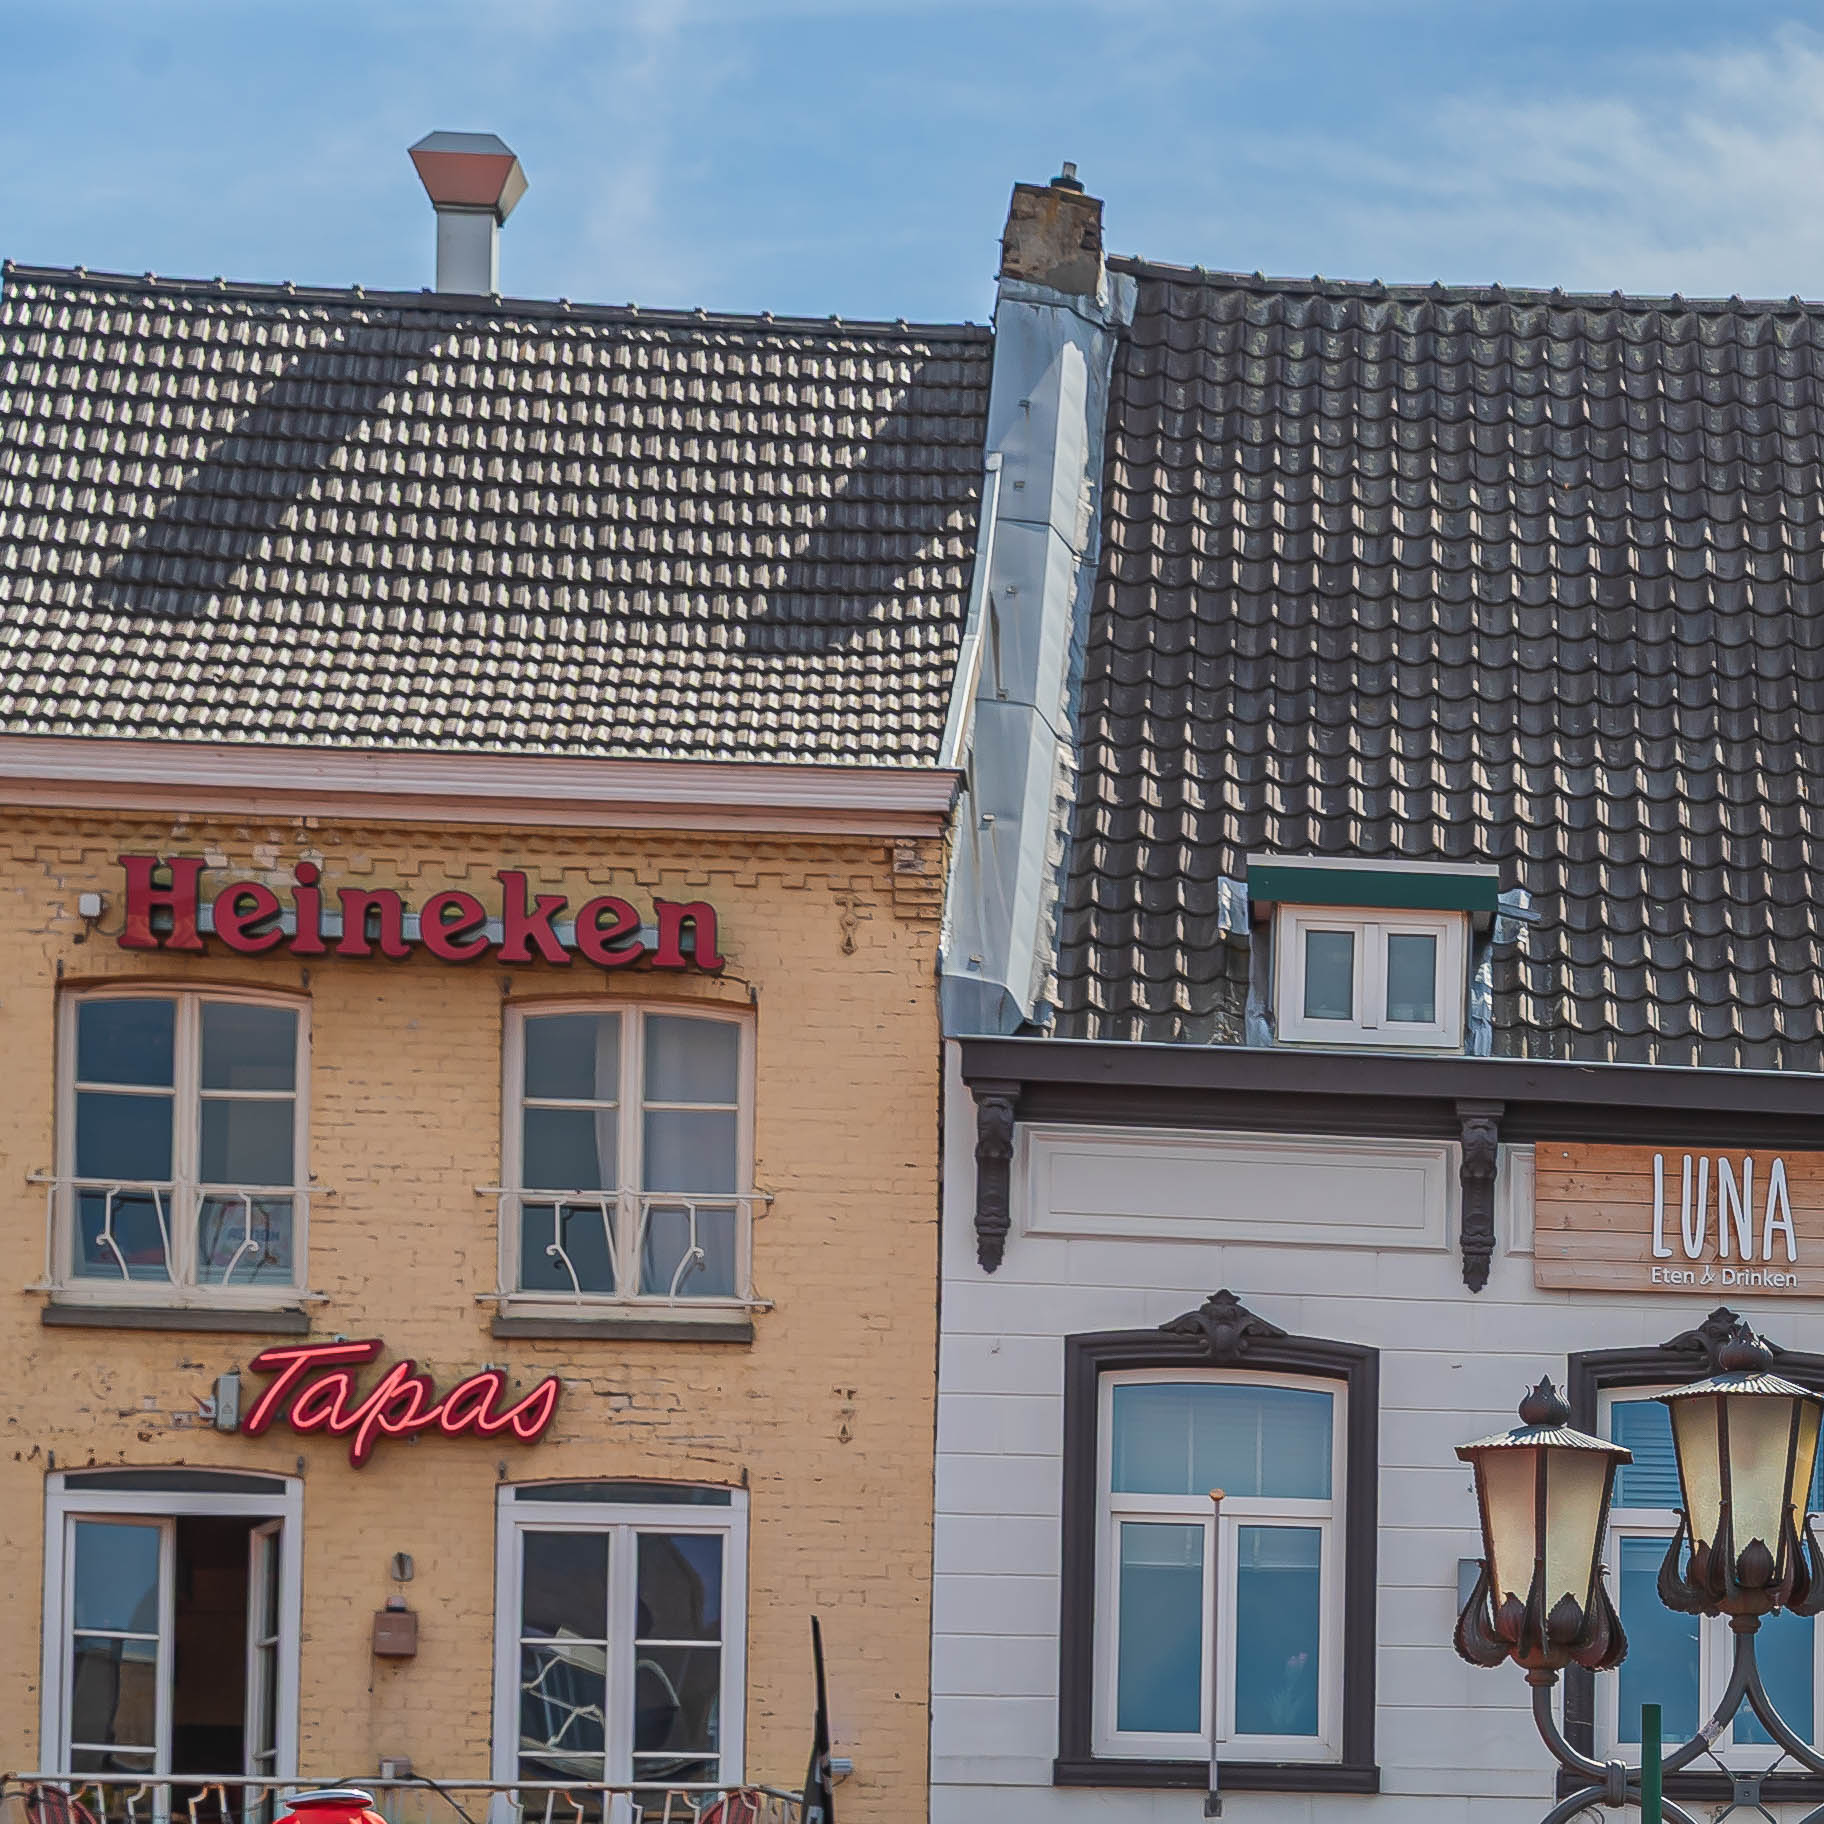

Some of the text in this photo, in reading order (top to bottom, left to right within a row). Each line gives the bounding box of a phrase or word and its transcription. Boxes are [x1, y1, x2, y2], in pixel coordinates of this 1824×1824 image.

[116, 854, 727, 975] Heineken
[1652, 1153, 1797, 1263] LUNA
[1651, 1264, 1798, 1288] Eten & Drinken
[242, 1338, 562, 1469] Tapas
